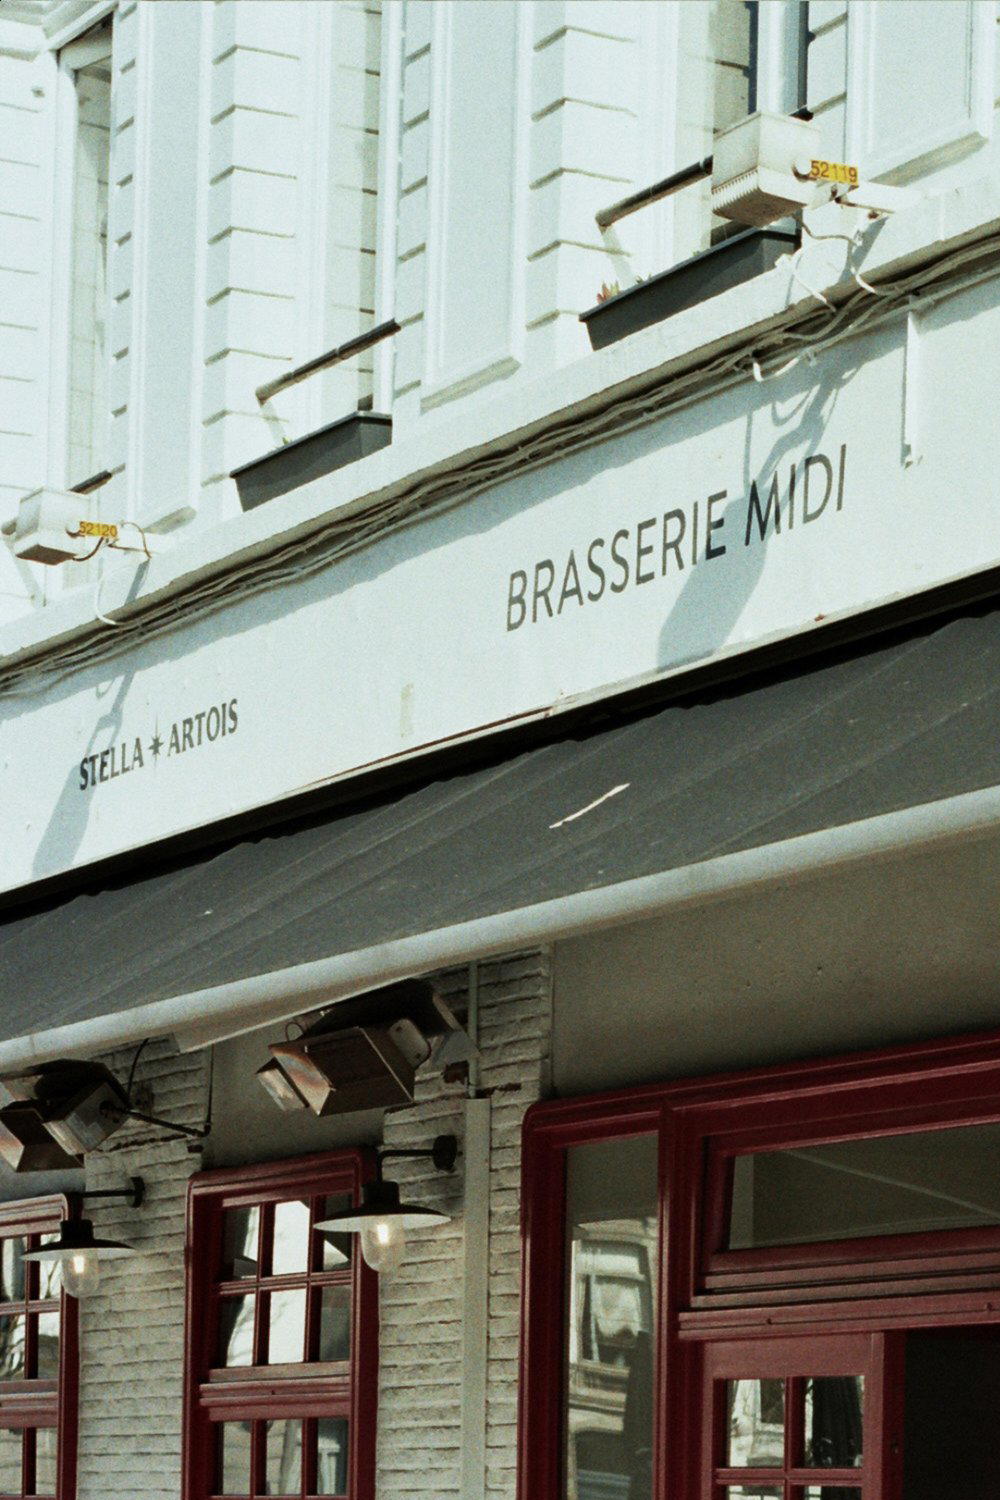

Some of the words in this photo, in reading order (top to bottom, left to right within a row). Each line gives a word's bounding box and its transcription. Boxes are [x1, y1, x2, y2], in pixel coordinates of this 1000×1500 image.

[810, 160, 858, 183] 52119
[79, 521, 118, 537] 52120
[506, 489, 728, 632] BRASSERIE
[744, 443, 847, 547] MIDI
[79, 737, 145, 791] STELLA
[167, 698, 239, 757] ARTOIS
